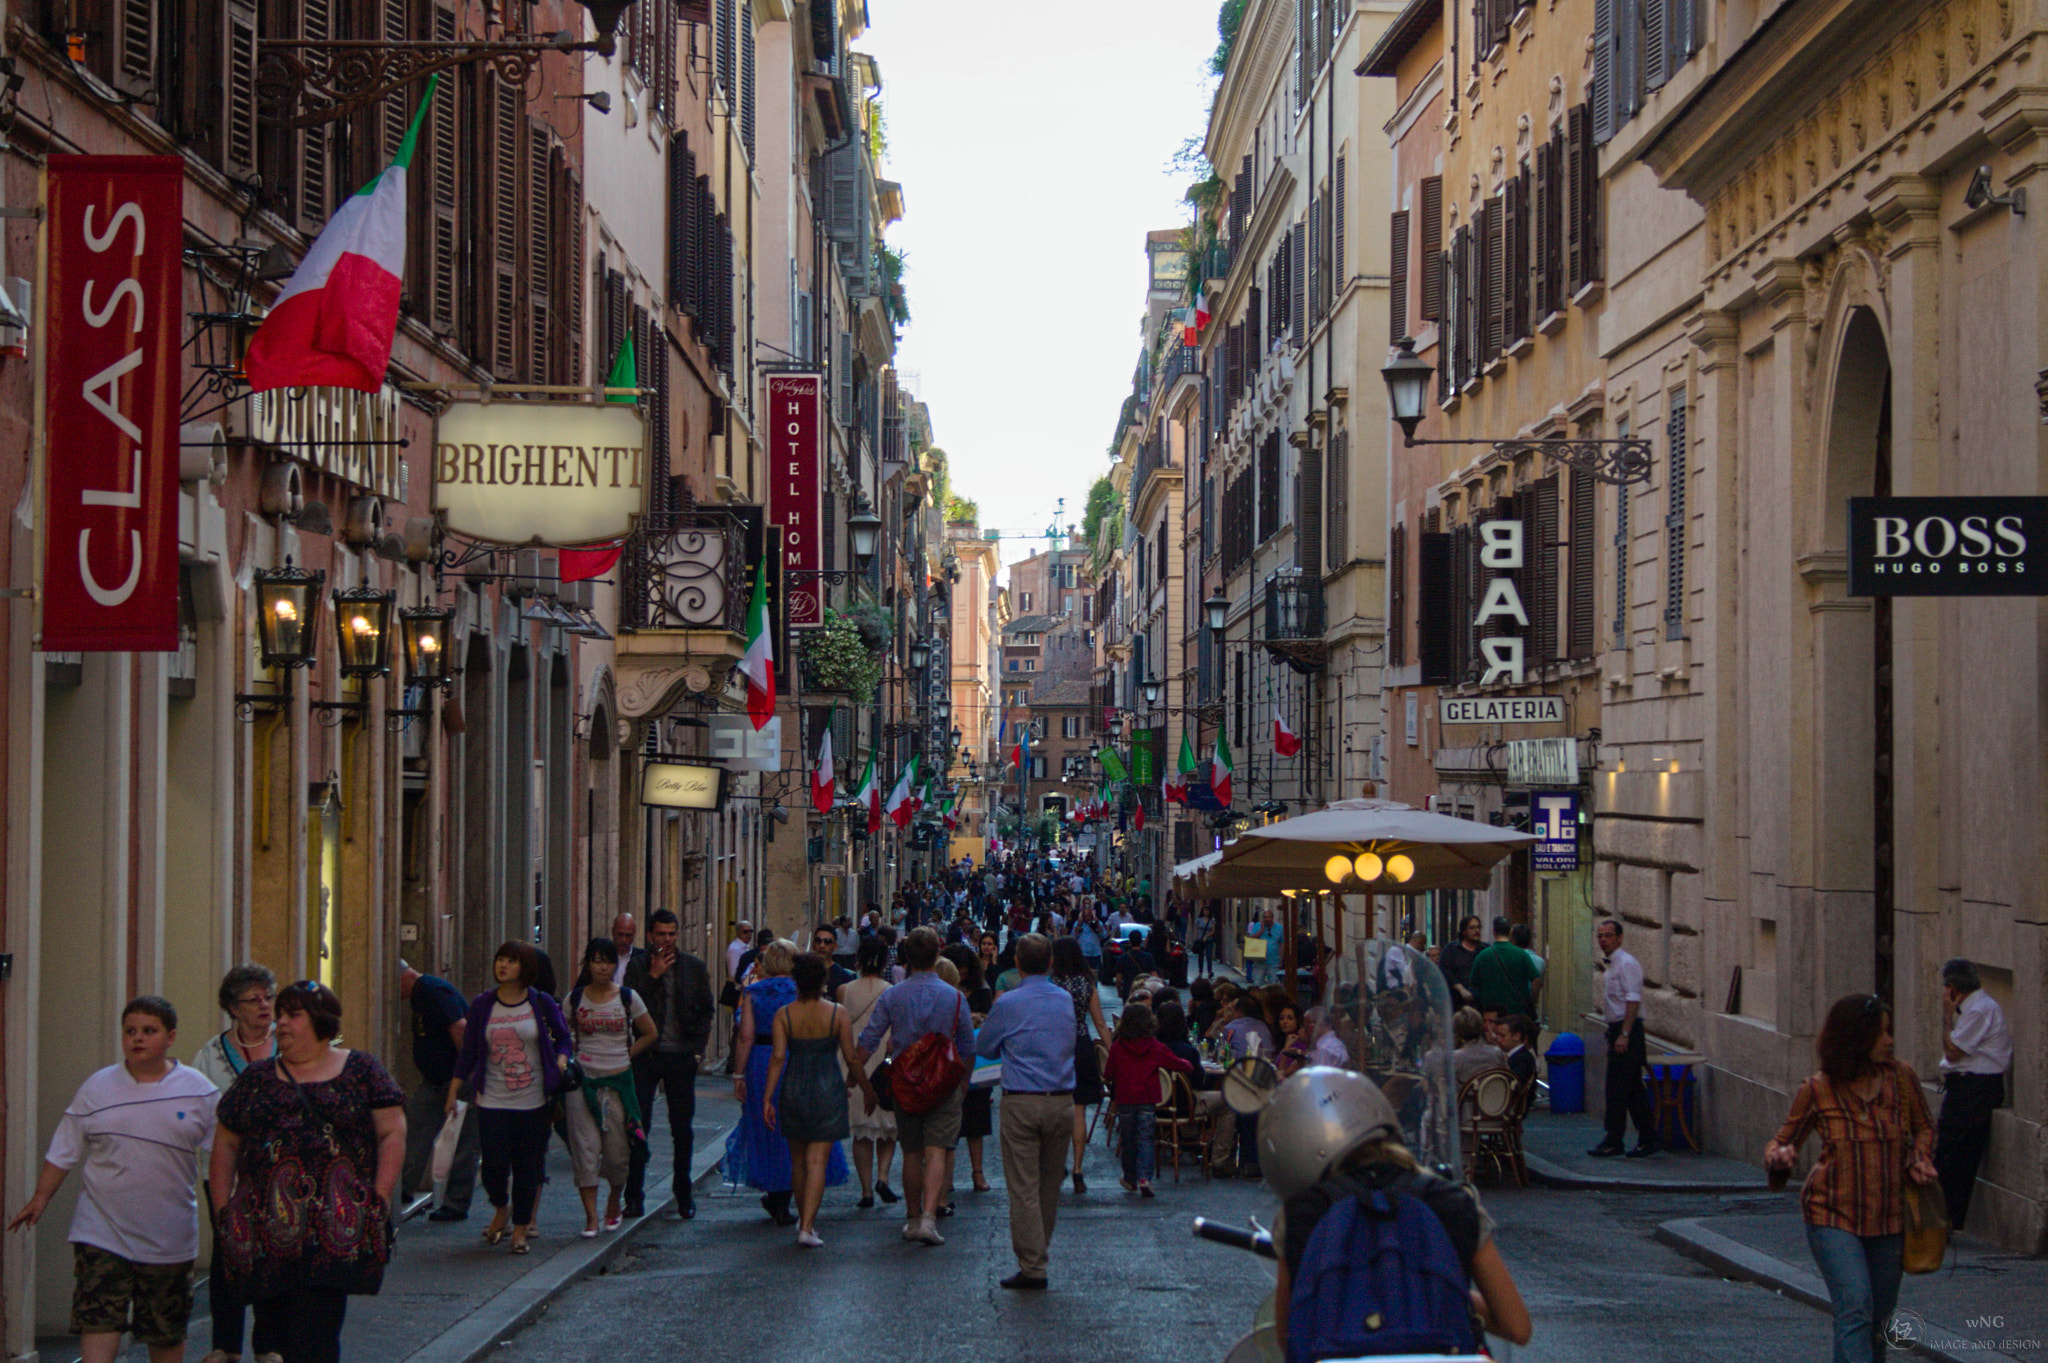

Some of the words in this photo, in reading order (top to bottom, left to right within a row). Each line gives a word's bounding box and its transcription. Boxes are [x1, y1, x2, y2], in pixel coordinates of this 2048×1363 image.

[78, 201, 146, 608] CLASS
[437, 443, 643, 488] BRIGHENTI
[787, 401, 800, 496] HOTEL
[788, 512, 802, 586] HOM
[1873, 515, 2027, 559] BOSS
[1873, 562, 1941, 574] HUGO
[1958, 562, 2027, 574] BOSS
[1447, 700, 1558, 720] GELATERIA
[1538, 796, 1572, 839] T
